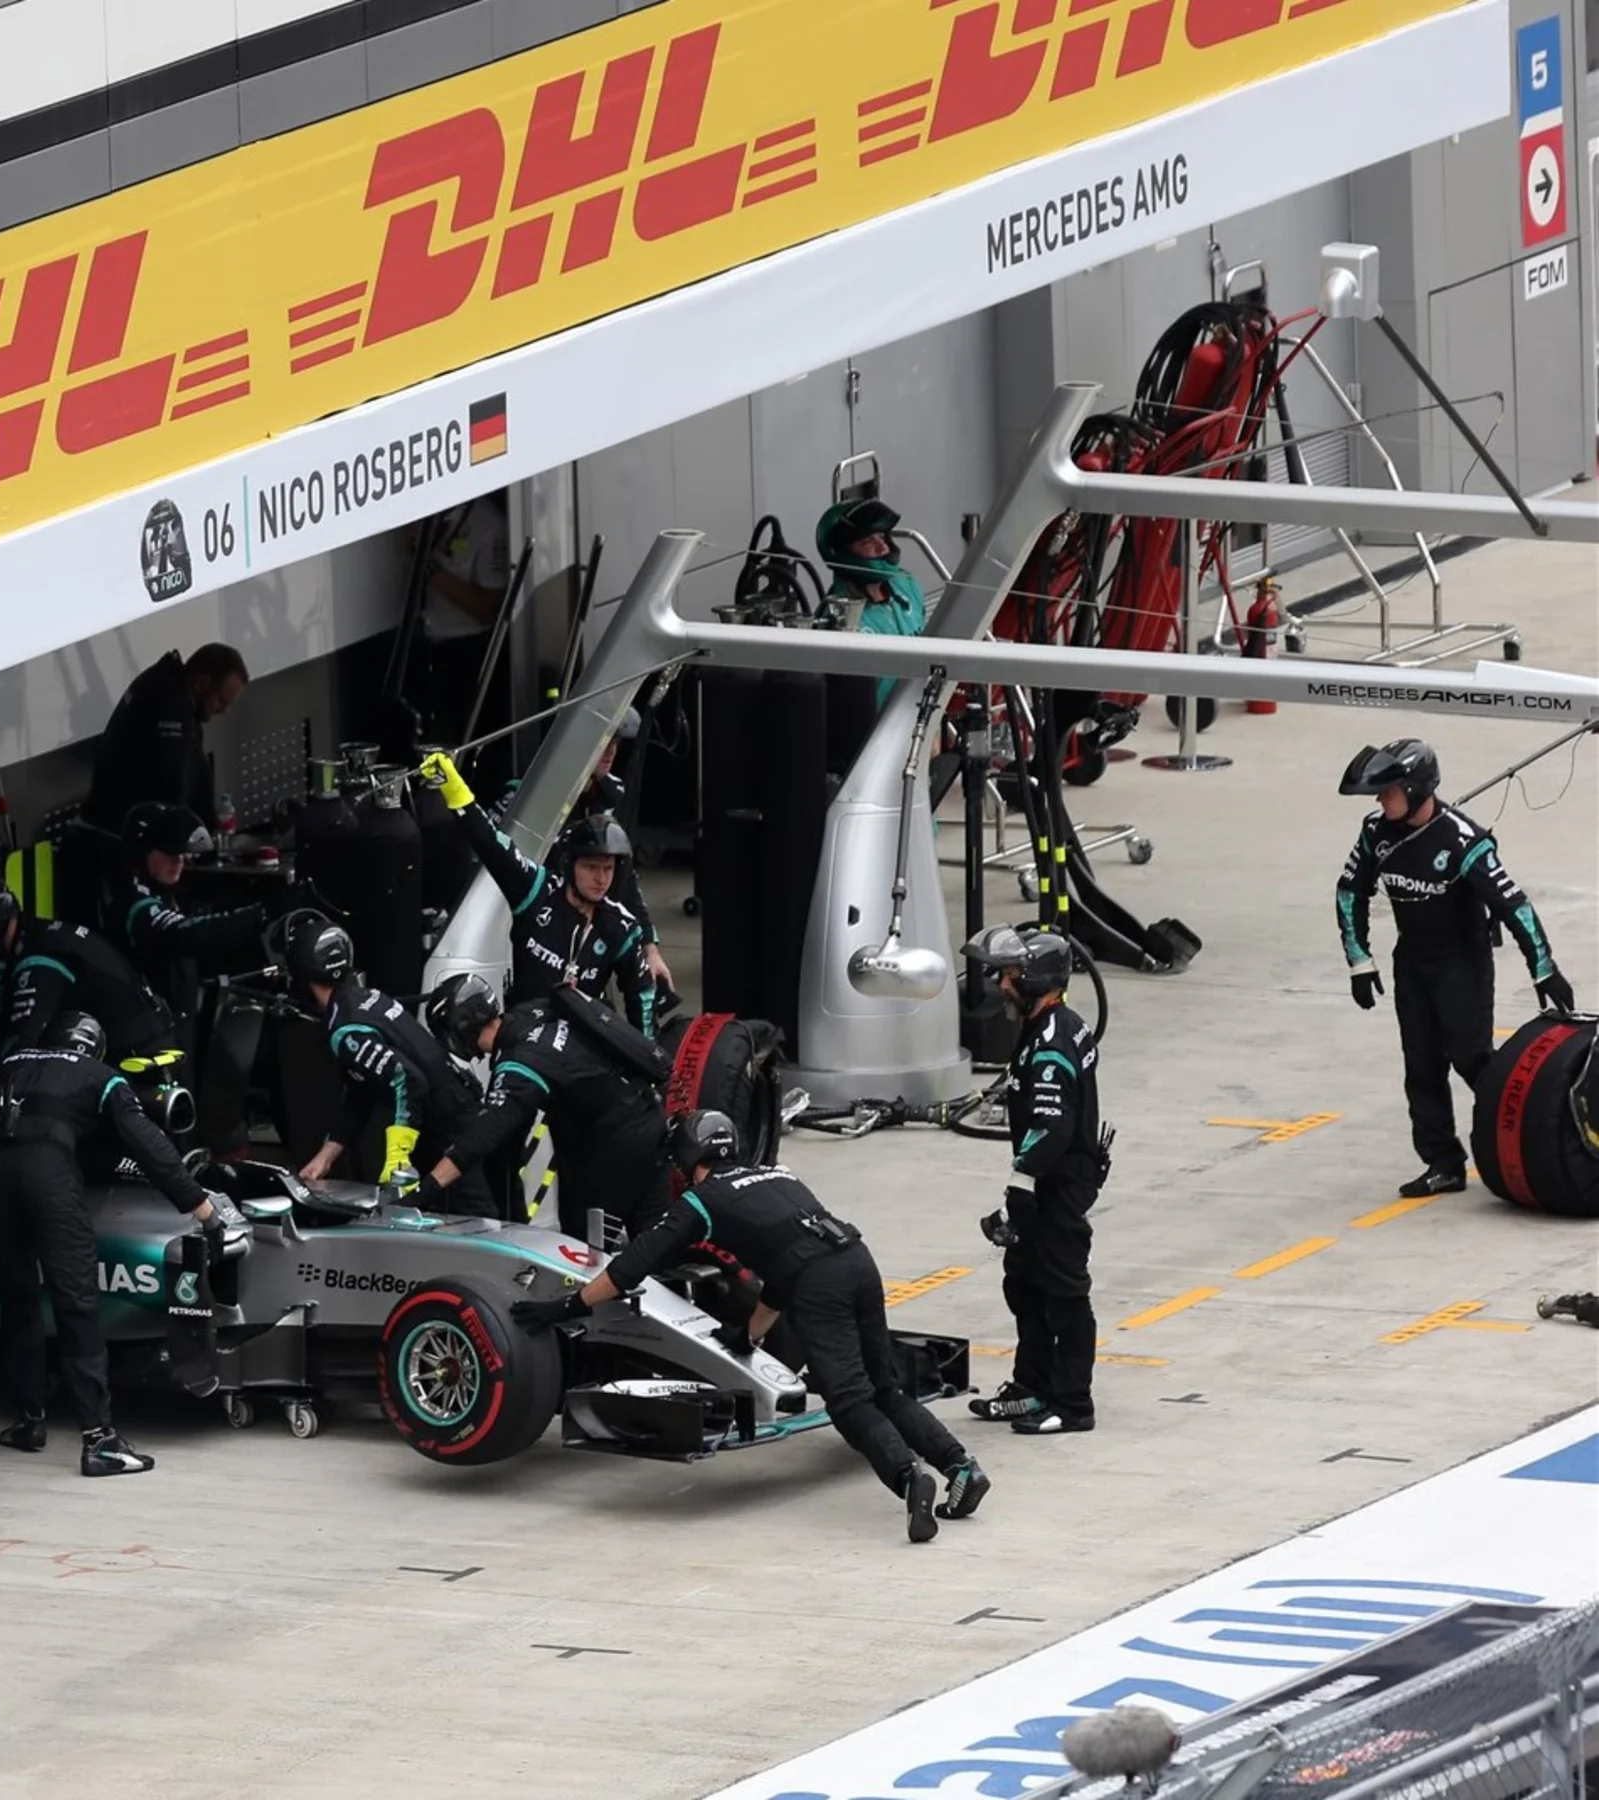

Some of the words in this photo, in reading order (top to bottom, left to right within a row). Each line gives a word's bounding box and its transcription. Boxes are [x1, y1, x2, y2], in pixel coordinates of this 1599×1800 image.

[1531, 49, 1548, 90] 5
[362, 23, 747, 348] DHL
[986, 175, 1126, 274] MERCEDES
[1133, 153, 1189, 221] AMG
[1528, 258, 1565, 292] FOM
[203, 503, 235, 563] 06
[259, 472, 325, 543] NICO
[334, 419, 463, 516] ROSBERG
[1501, 1078, 1525, 1133] REAR
[168, 1306, 213, 1317] PETRONAS
